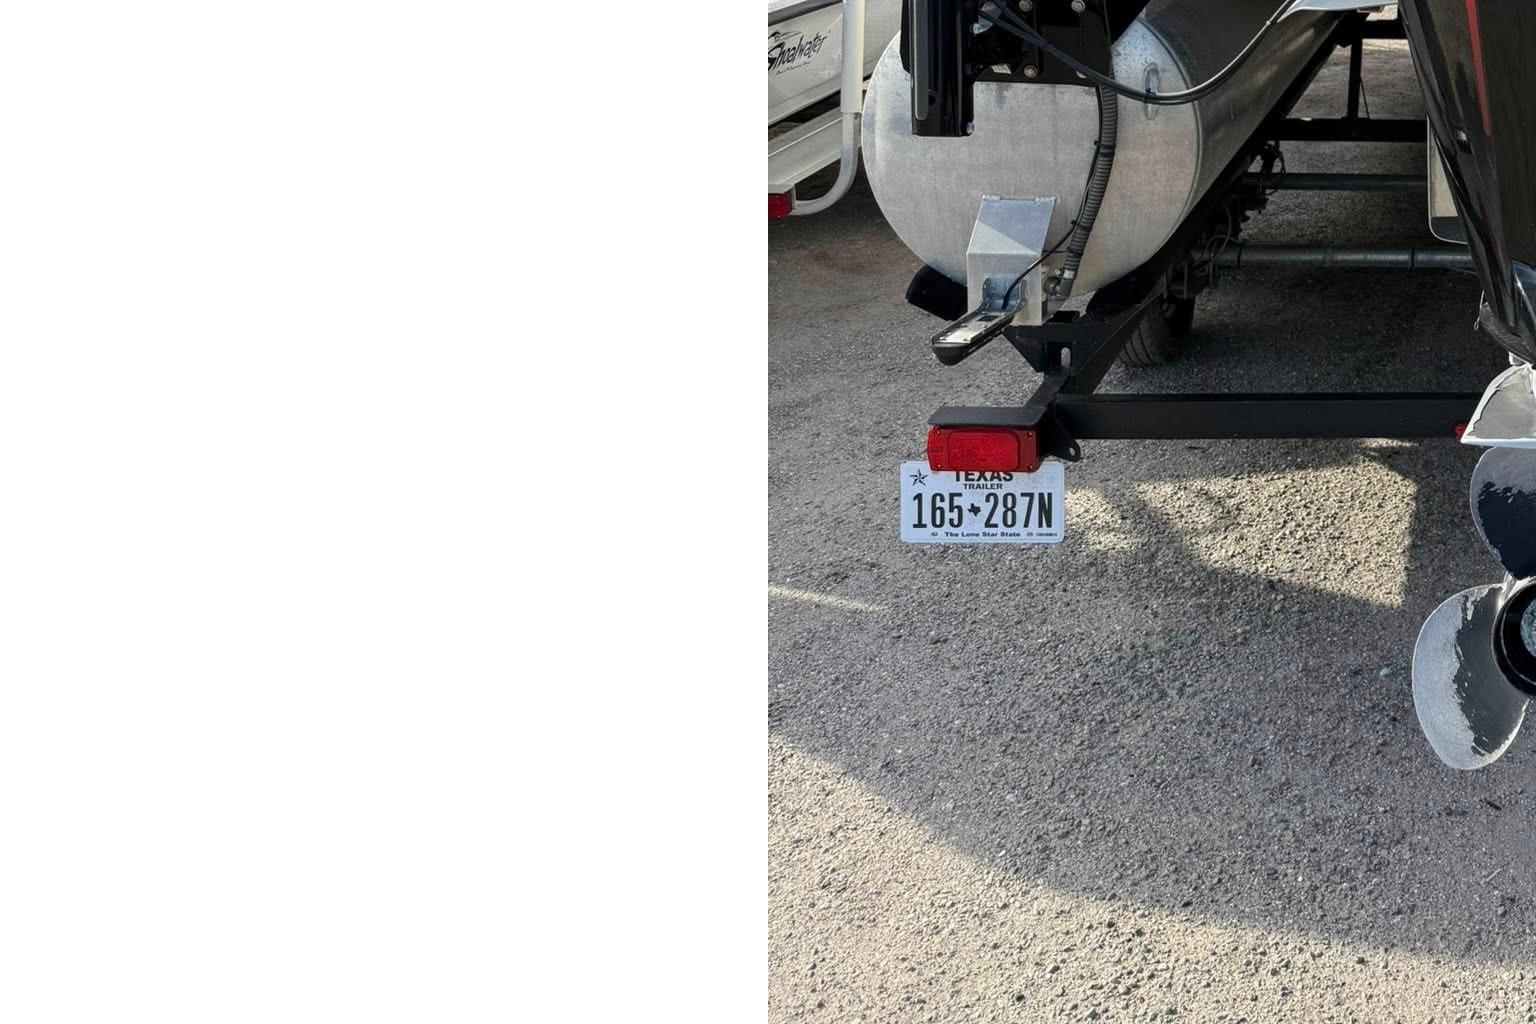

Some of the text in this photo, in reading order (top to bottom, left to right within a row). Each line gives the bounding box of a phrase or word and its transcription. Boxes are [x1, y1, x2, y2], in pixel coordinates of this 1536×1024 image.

[954, 471, 1014, 482] TEXAS
[912, 492, 1053, 529] 165 287N
